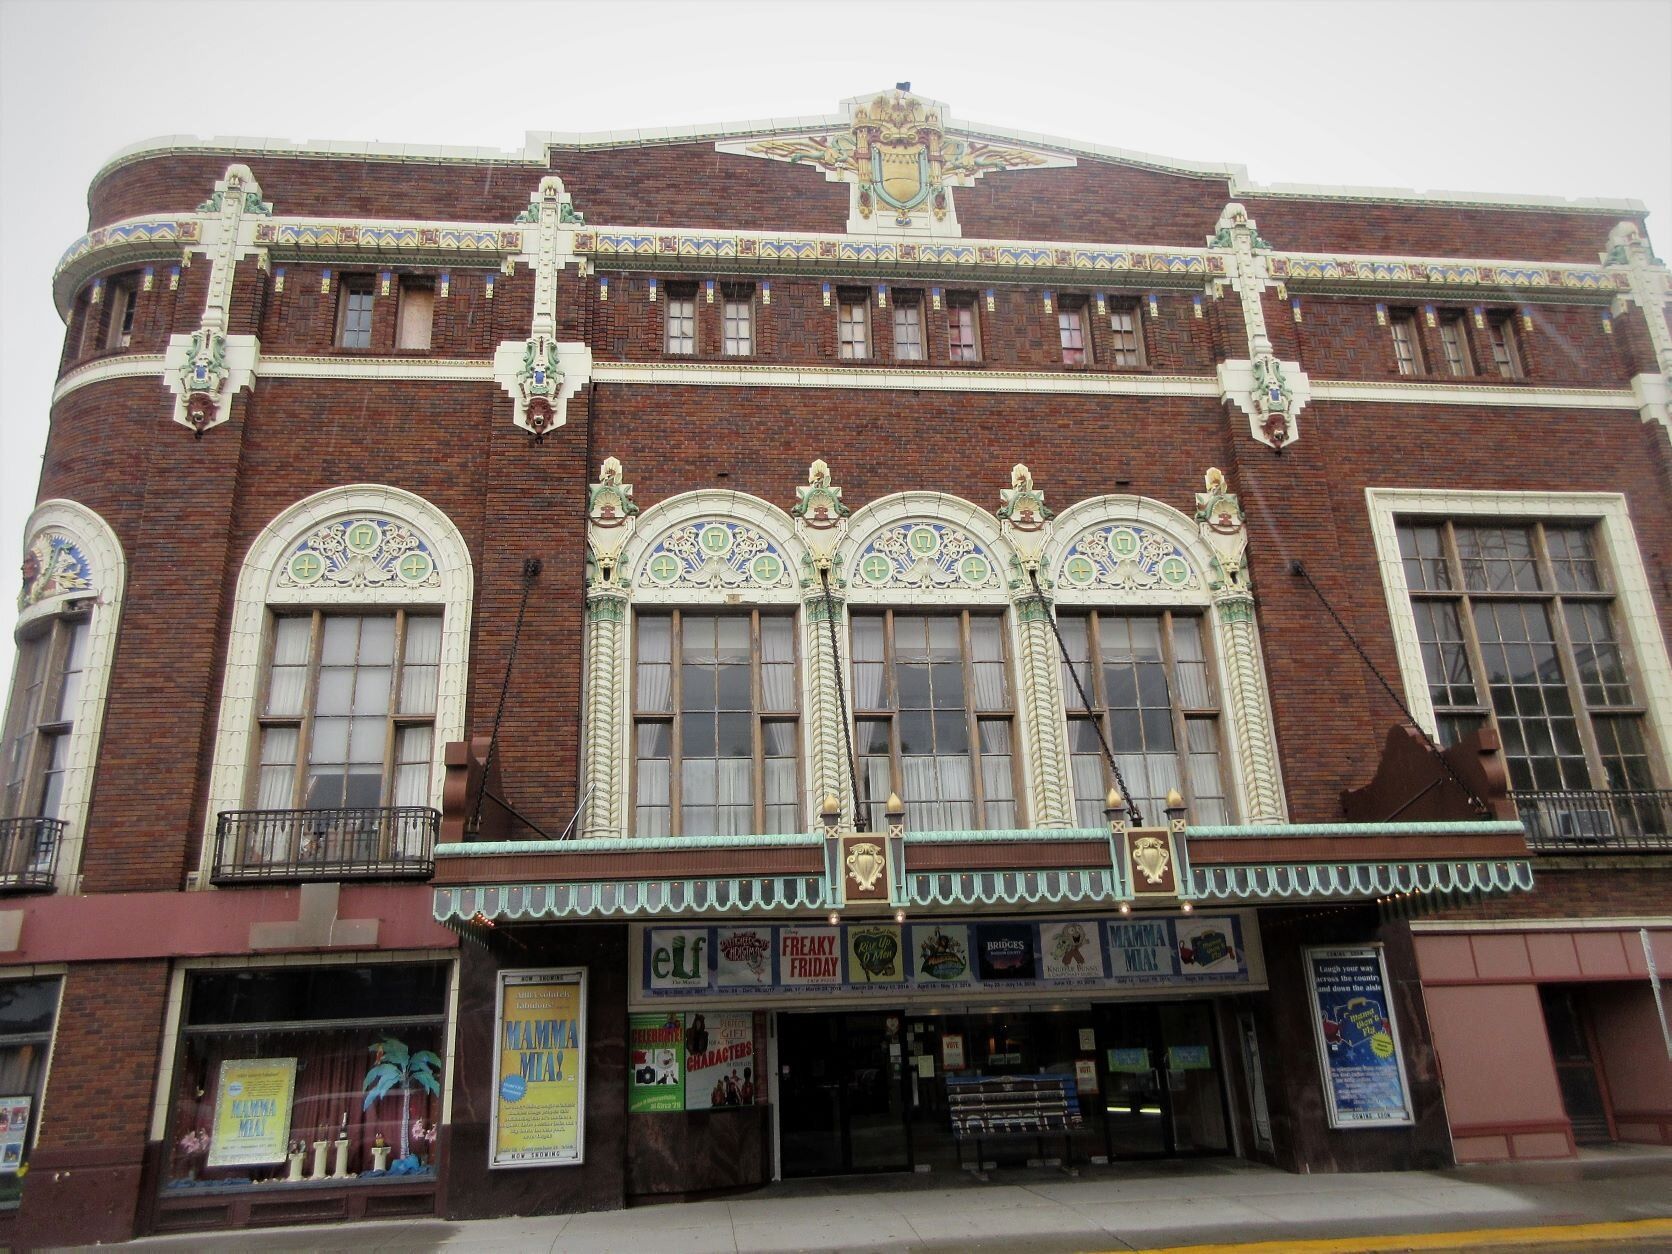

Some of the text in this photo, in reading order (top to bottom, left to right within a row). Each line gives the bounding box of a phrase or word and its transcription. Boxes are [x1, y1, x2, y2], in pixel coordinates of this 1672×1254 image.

[1109, 924, 1166, 948] MAMMA
[782, 936, 836, 956] FREAKY
[987, 940, 1025, 950] BRIDGES
[652, 935, 706, 979] elf
[1124, 948, 1159, 972] MIA!
[790, 957, 839, 978] FRIDAY
[1320, 965, 1341, 973] Laugh
[1354, 974, 1380, 982] country
[1332, 984, 1351, 992] down
[720, 1020, 745, 1028] PERFECT
[504, 1020, 579, 1050] MAMMA
[721, 1029, 745, 1038] GIFT
[945, 1041, 959, 1049] VOTE
[686, 1041, 752, 1072] CHARACTERS
[519, 1051, 564, 1083] MIA!
[1079, 1066, 1092, 1074] VOTE
[232, 1099, 277, 1118] MAMMA
[1351, 1112, 1373, 1120] COMING
[531, 1150, 560, 1158] SHOWING
